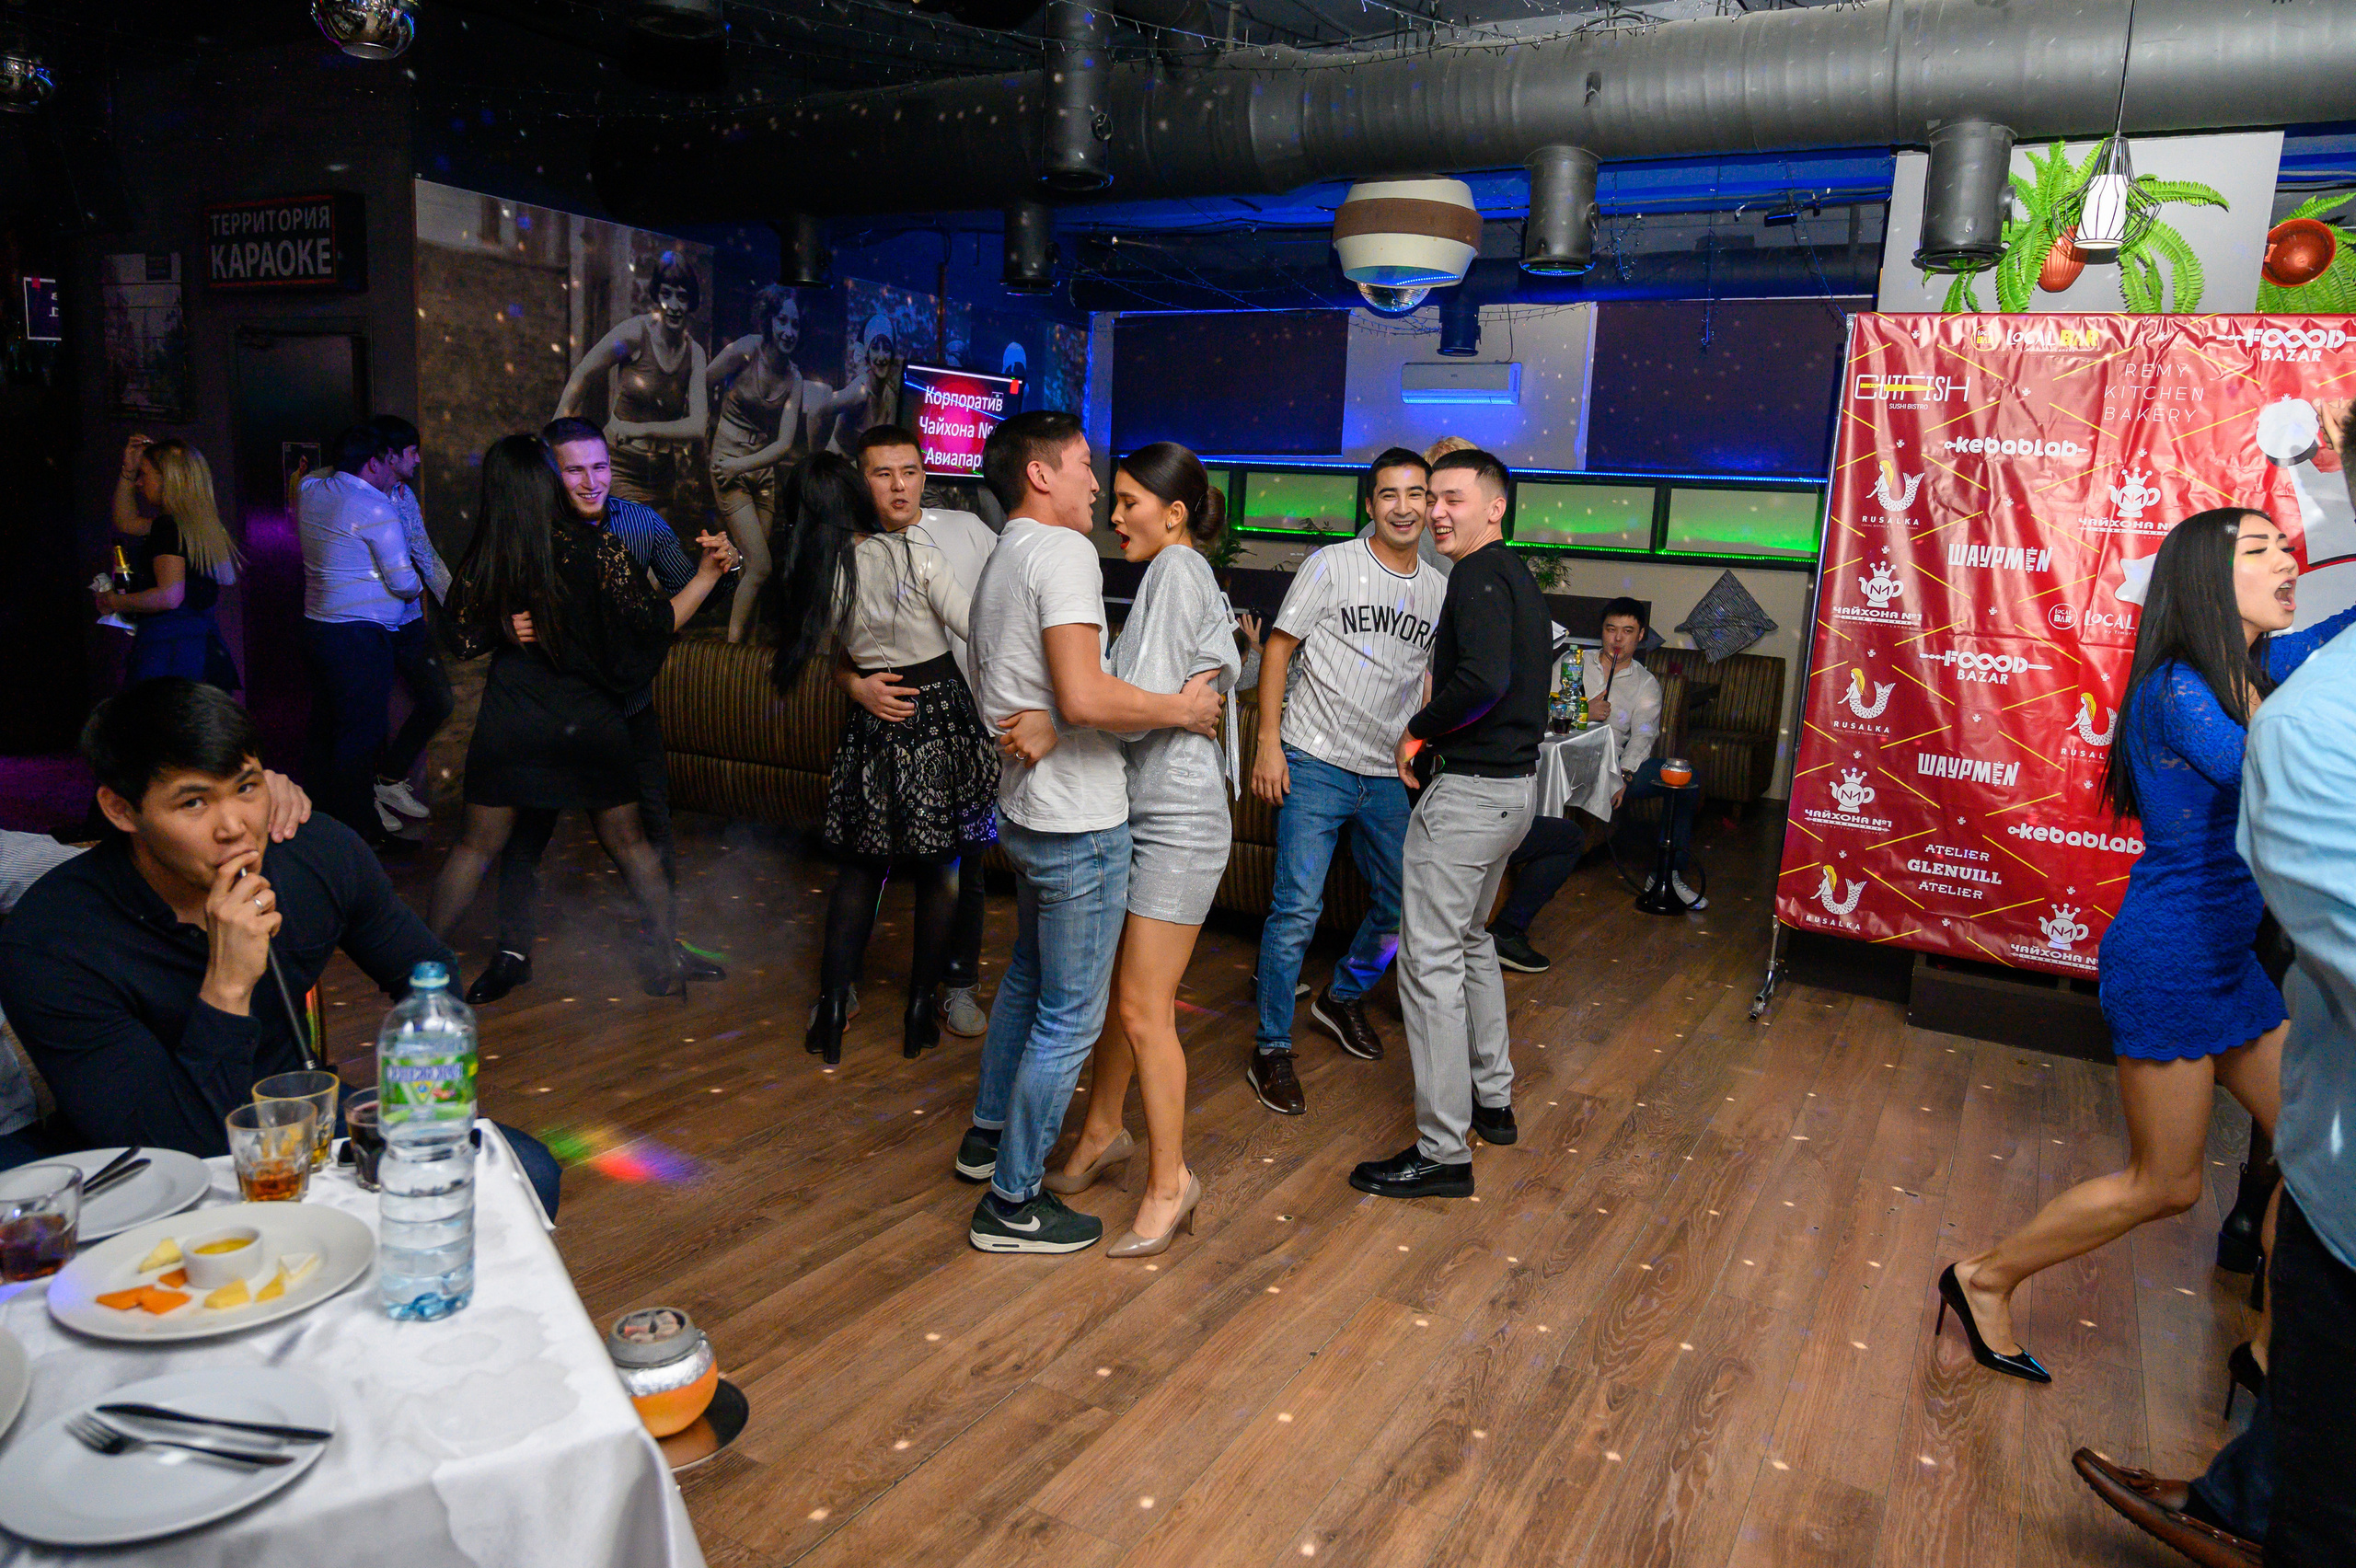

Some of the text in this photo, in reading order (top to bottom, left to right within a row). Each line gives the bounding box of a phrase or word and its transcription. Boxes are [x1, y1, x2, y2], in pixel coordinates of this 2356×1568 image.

[210, 205, 329, 236] ТЕРРИТОРИЯ
[211, 237, 332, 280] КАРАОКЕ
[2059, 329, 2100, 347] BAR
[2260, 349, 2322, 363] BAZAR
[2125, 363, 2189, 378] REMY
[924, 386, 1003, 412] Корпоратив
[2104, 385, 2204, 402] KITCHEN
[2104, 406, 2197, 423] BAKERY
[919, 415, 975, 438] Чайхона
[924, 446, 983, 471] Авиапар
[1861, 515, 1920, 525] RUSALKA
[2078, 516, 2154, 530] ЧАЙХОНА
[1832, 605, 1899, 619] ЧАЙХОНА
[2053, 614, 2073, 624] BAR
[2084, 609, 2135, 630] LOCAL
[1957, 669, 2009, 686] BAZAR
[1833, 721, 1890, 733] RUSALKA
[2061, 747, 2105, 760] RUSAL
[1804, 809, 1869, 824] ЧАЙХОНА
[1924, 844, 1990, 862] ATELIER
[1907, 859, 2002, 885] GLENUILL
[1918, 881, 1983, 900] ATELIER
[1806, 915, 1861, 930] RUSALKA
[2010, 943, 2083, 963] ЧАЙХОНА
